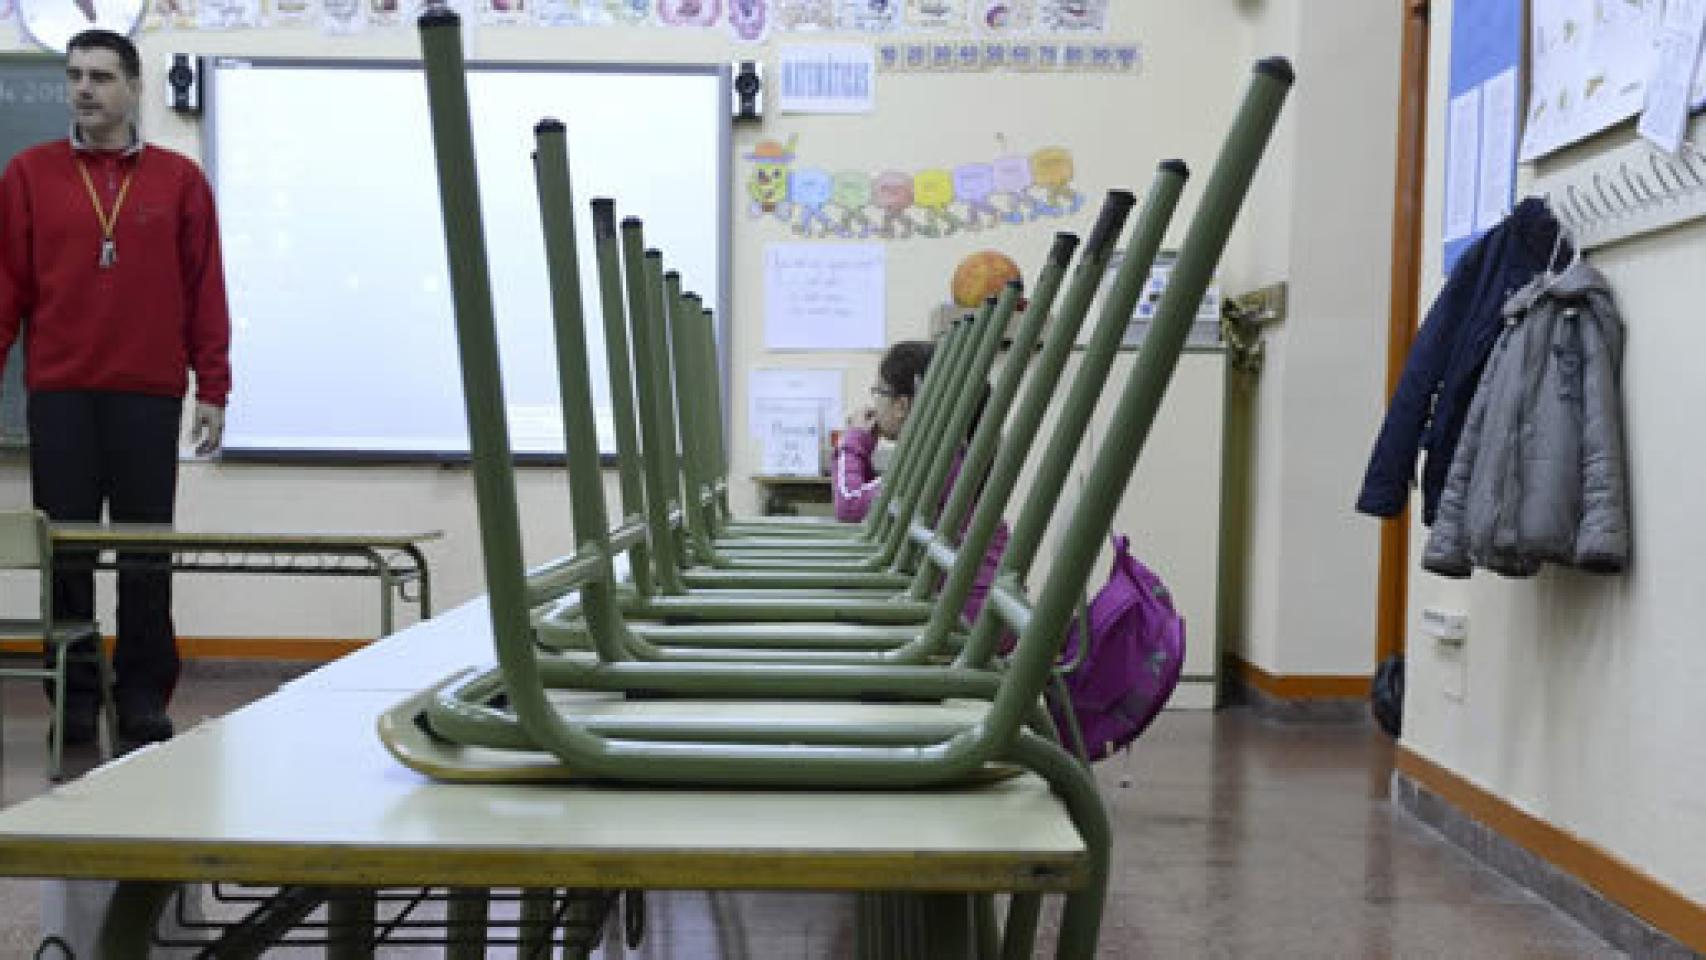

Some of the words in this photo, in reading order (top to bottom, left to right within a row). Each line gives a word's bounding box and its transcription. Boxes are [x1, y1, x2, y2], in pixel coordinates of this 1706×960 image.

[881, 45, 896, 63] 10
[907, 45, 924, 63] 20
[986, 45, 1004, 63] 50
